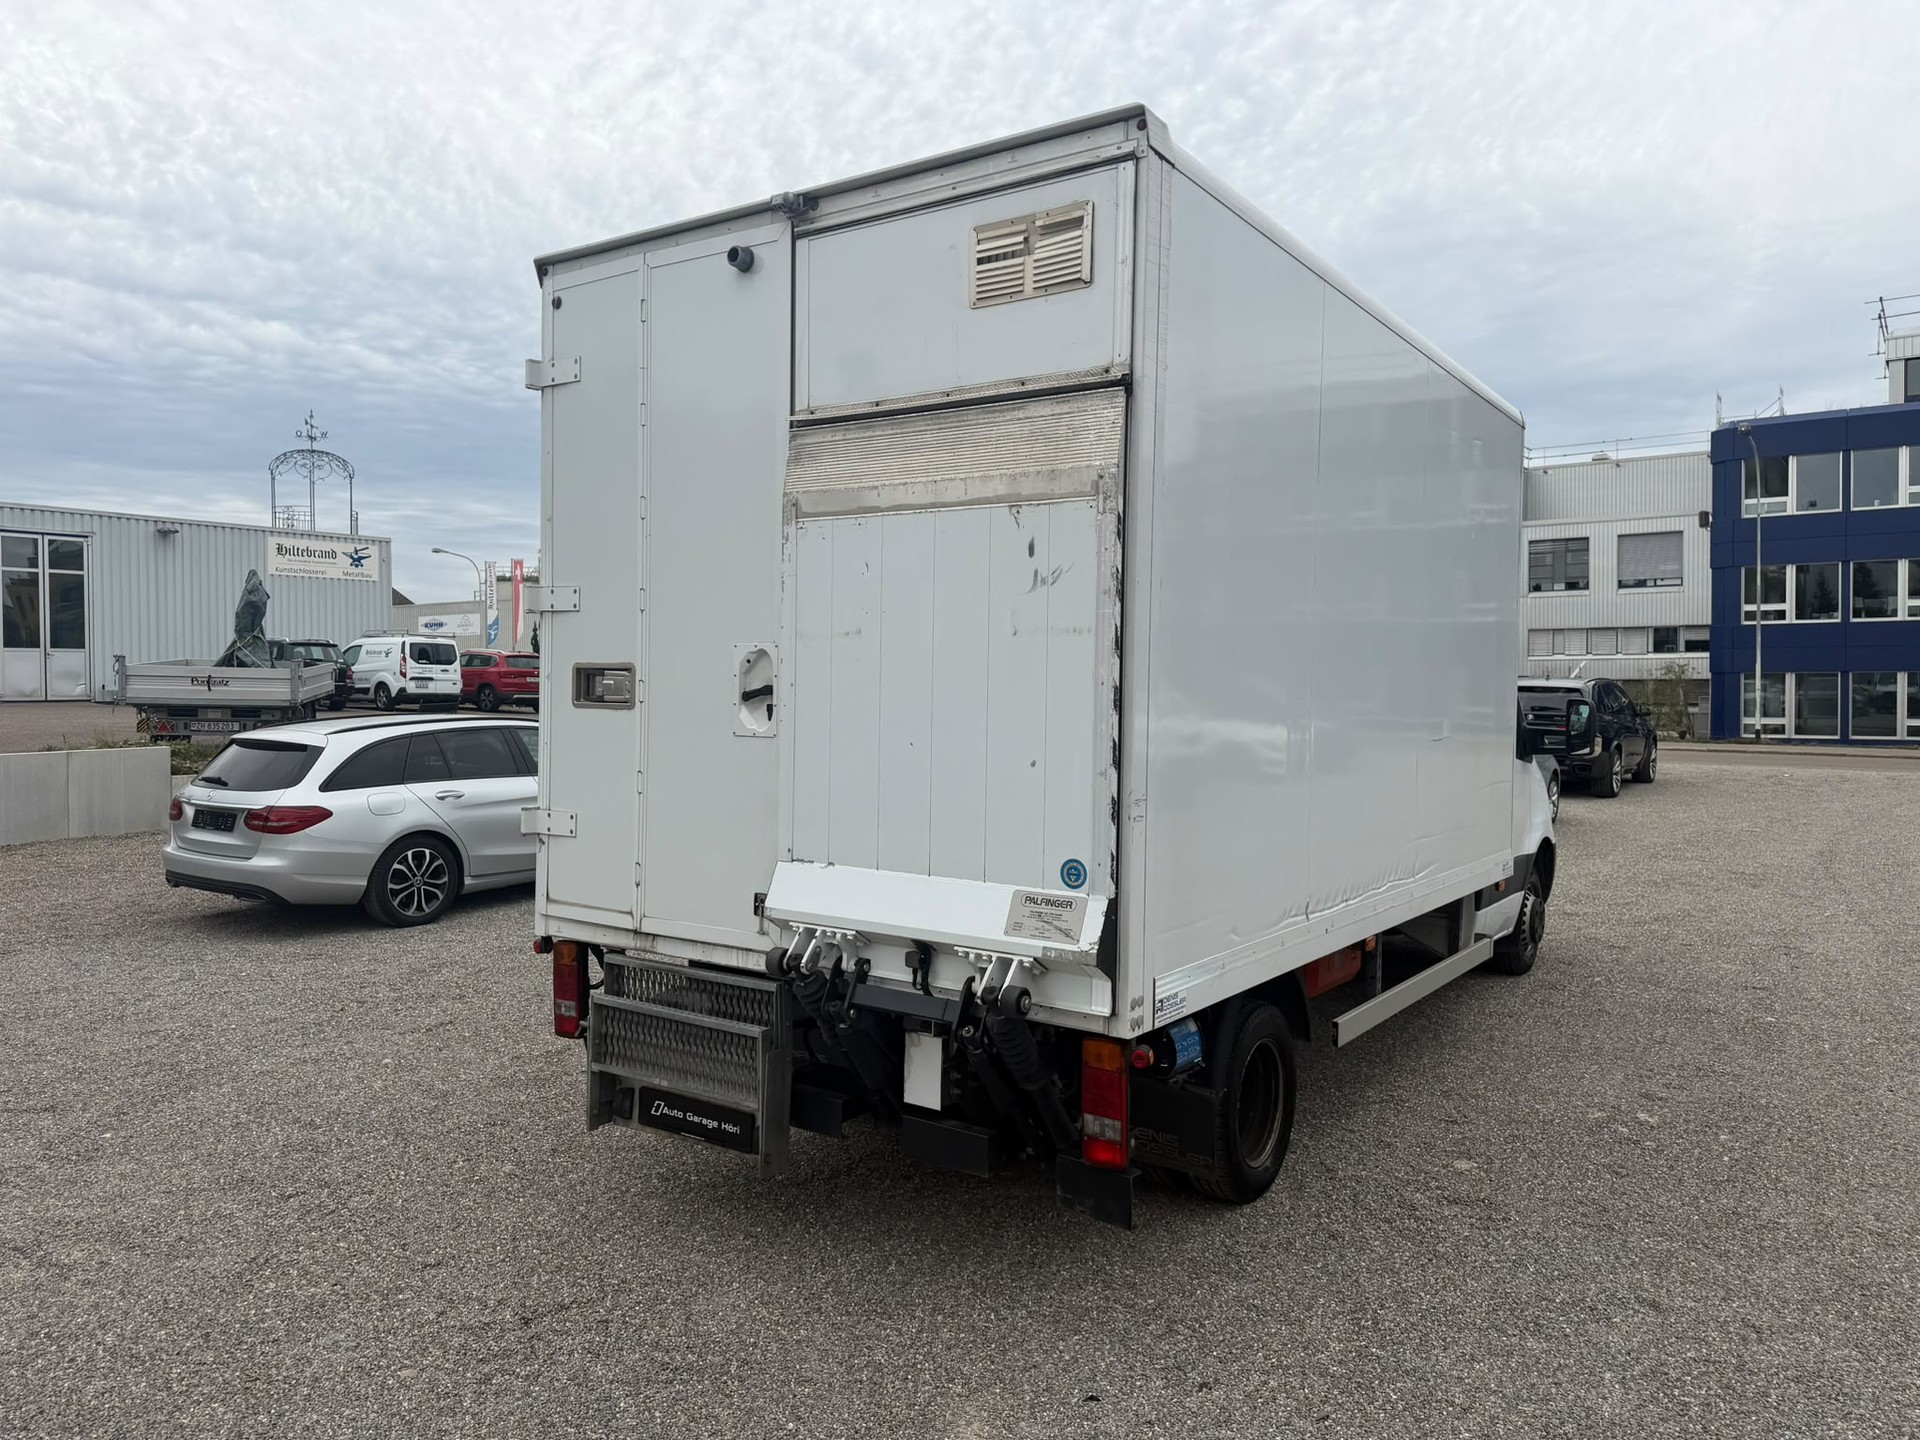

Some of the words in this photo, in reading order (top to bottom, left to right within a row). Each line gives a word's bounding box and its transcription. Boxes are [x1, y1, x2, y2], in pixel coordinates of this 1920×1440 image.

[275, 542, 338, 560] Hiltebrand
[275, 566, 327, 576] Kunstschlosserei
[342, 571, 372, 579] Metallbau
[196, 722, 205, 730] ZH
[1024, 895, 1073, 909] PALFINGER
[663, 1107, 683, 1119] Auto
[686, 1112, 718, 1129] Garage
[721, 1121, 740, 1134] Höri
[1136, 1127, 1178, 1144] ENIS
